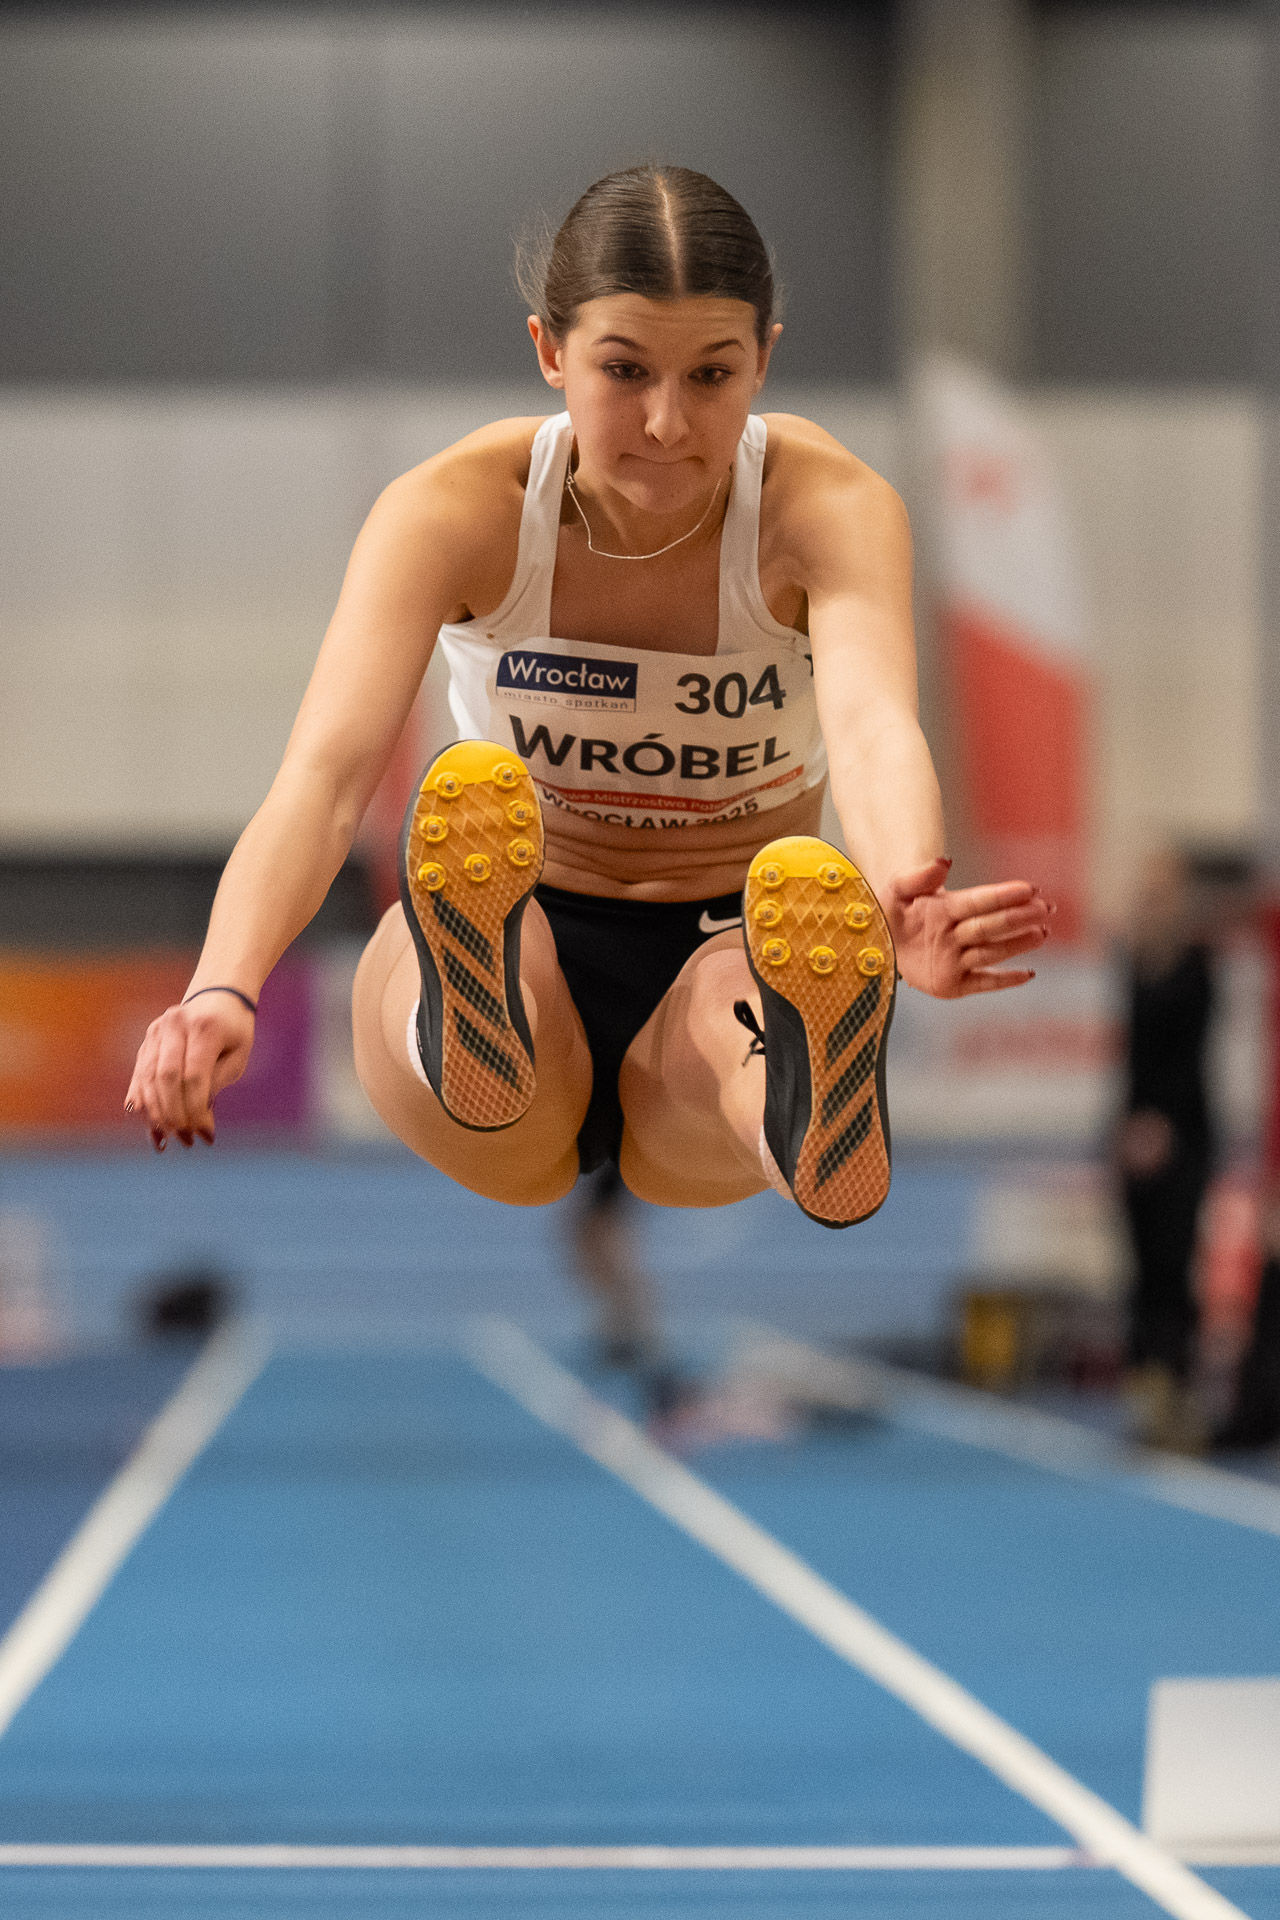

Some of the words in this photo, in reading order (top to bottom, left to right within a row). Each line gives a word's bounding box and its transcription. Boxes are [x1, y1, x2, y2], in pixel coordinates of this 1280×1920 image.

[507, 656, 630, 690] Wrocław
[504, 691, 558, 704] miasto
[566, 699, 628, 709] spotkań
[675, 664, 786, 719] 304
[509, 714, 790, 780] WRÓBEL
[594, 793, 686, 809] Mistrzostwa
